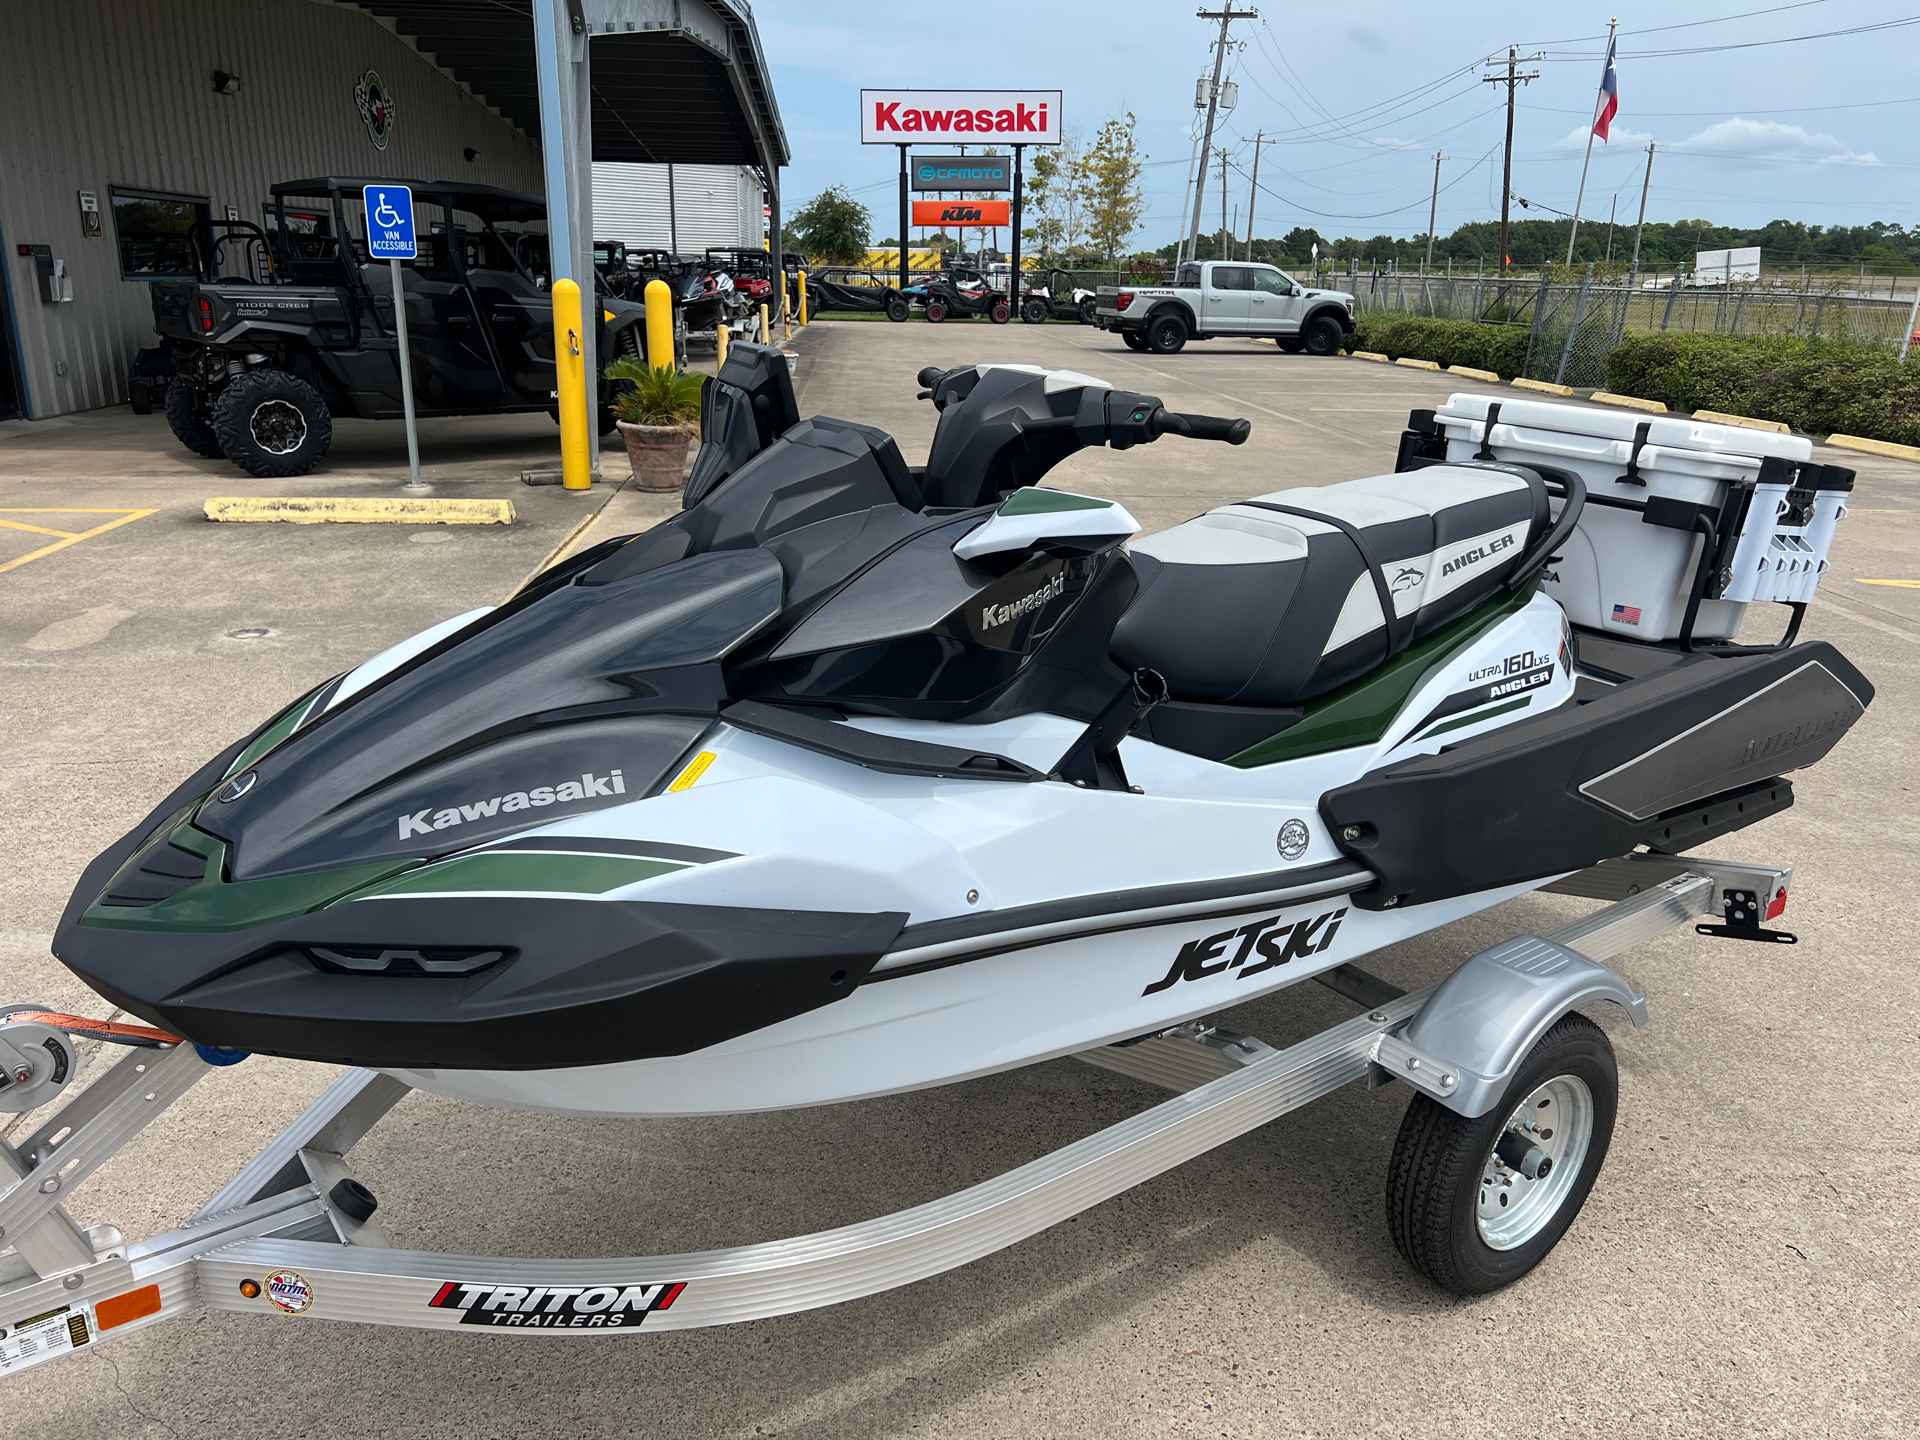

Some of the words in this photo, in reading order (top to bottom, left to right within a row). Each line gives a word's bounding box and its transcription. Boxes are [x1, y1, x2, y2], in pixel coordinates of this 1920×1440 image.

[876, 102, 1047, 132] Kawasaki
[937, 168, 1004, 179] CFMOTO
[940, 206, 982, 222] KTM
[373, 241, 414, 251] ACCESSIBLE
[384, 231, 400, 240] VAN
[1442, 533, 1515, 577] ANGLER
[982, 571, 1064, 630] Kawasaki
[1468, 664, 1502, 682] ULTRA
[1503, 650, 1534, 677] 160
[1490, 671, 1550, 699] ANGLER
[398, 769, 626, 841] Kawasaki
[457, 1284, 665, 1313] TRITON
[492, 1313, 625, 1328] TRAILERS
